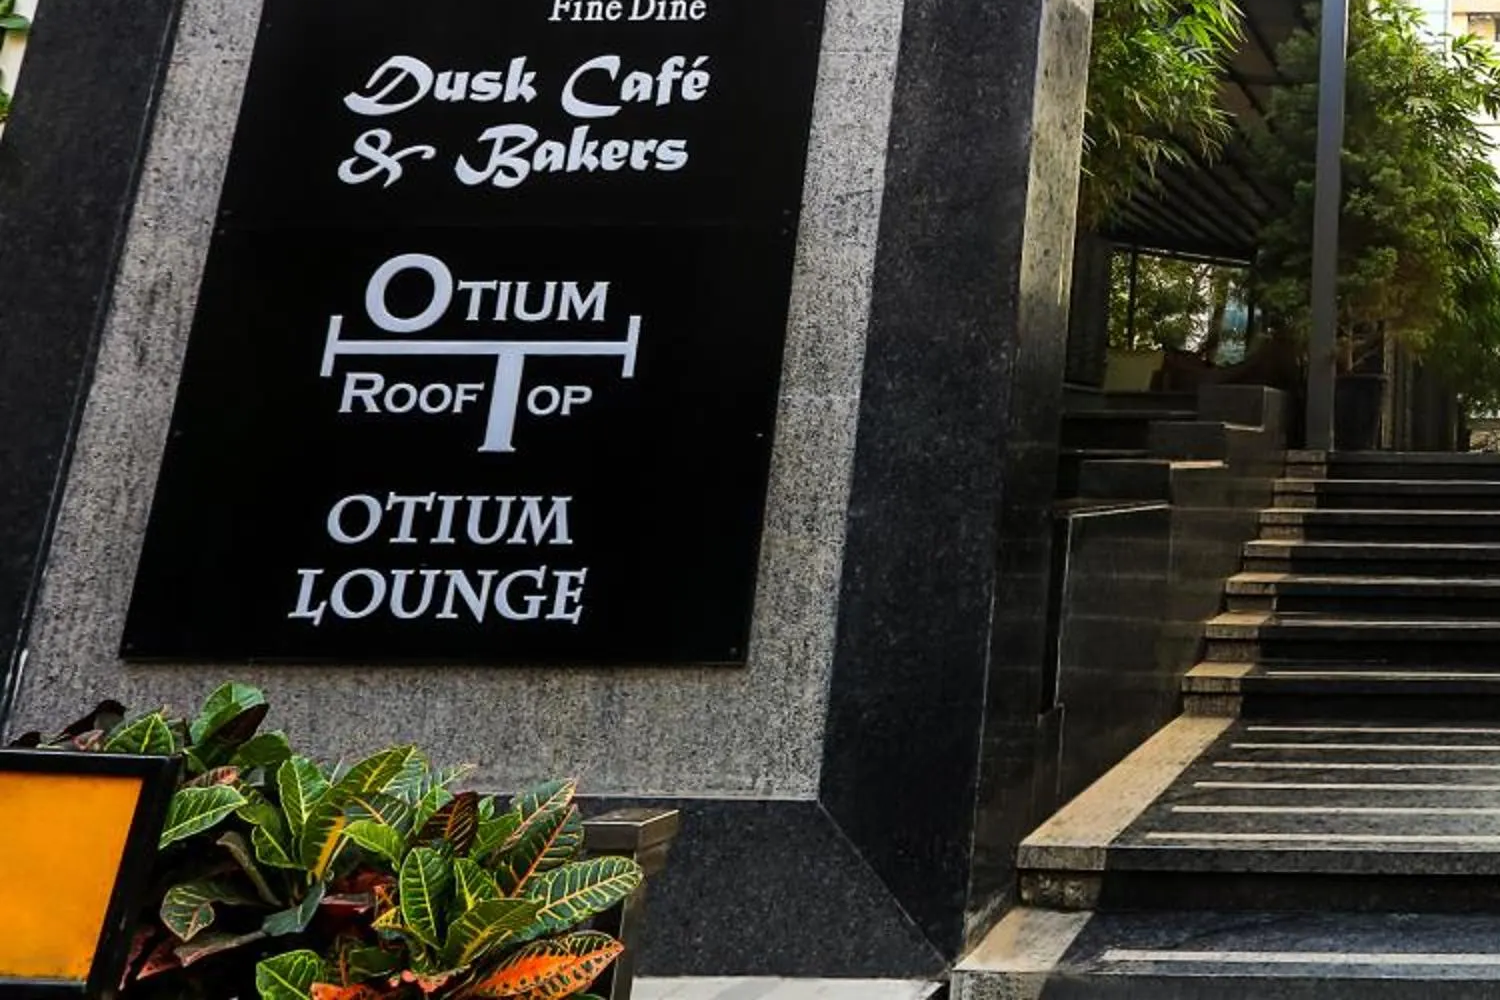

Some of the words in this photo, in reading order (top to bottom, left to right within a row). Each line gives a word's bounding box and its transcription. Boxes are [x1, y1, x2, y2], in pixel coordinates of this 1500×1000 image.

[343, 55, 537, 116] Dusk
[561, 54, 711, 118] Café
[337, 128, 435, 188] &
[454, 123, 689, 188] Bakers
[365, 253, 610, 333] OTIUM
[327, 491, 573, 546] OTIUM
[287, 564, 588, 626] LOUNGE
